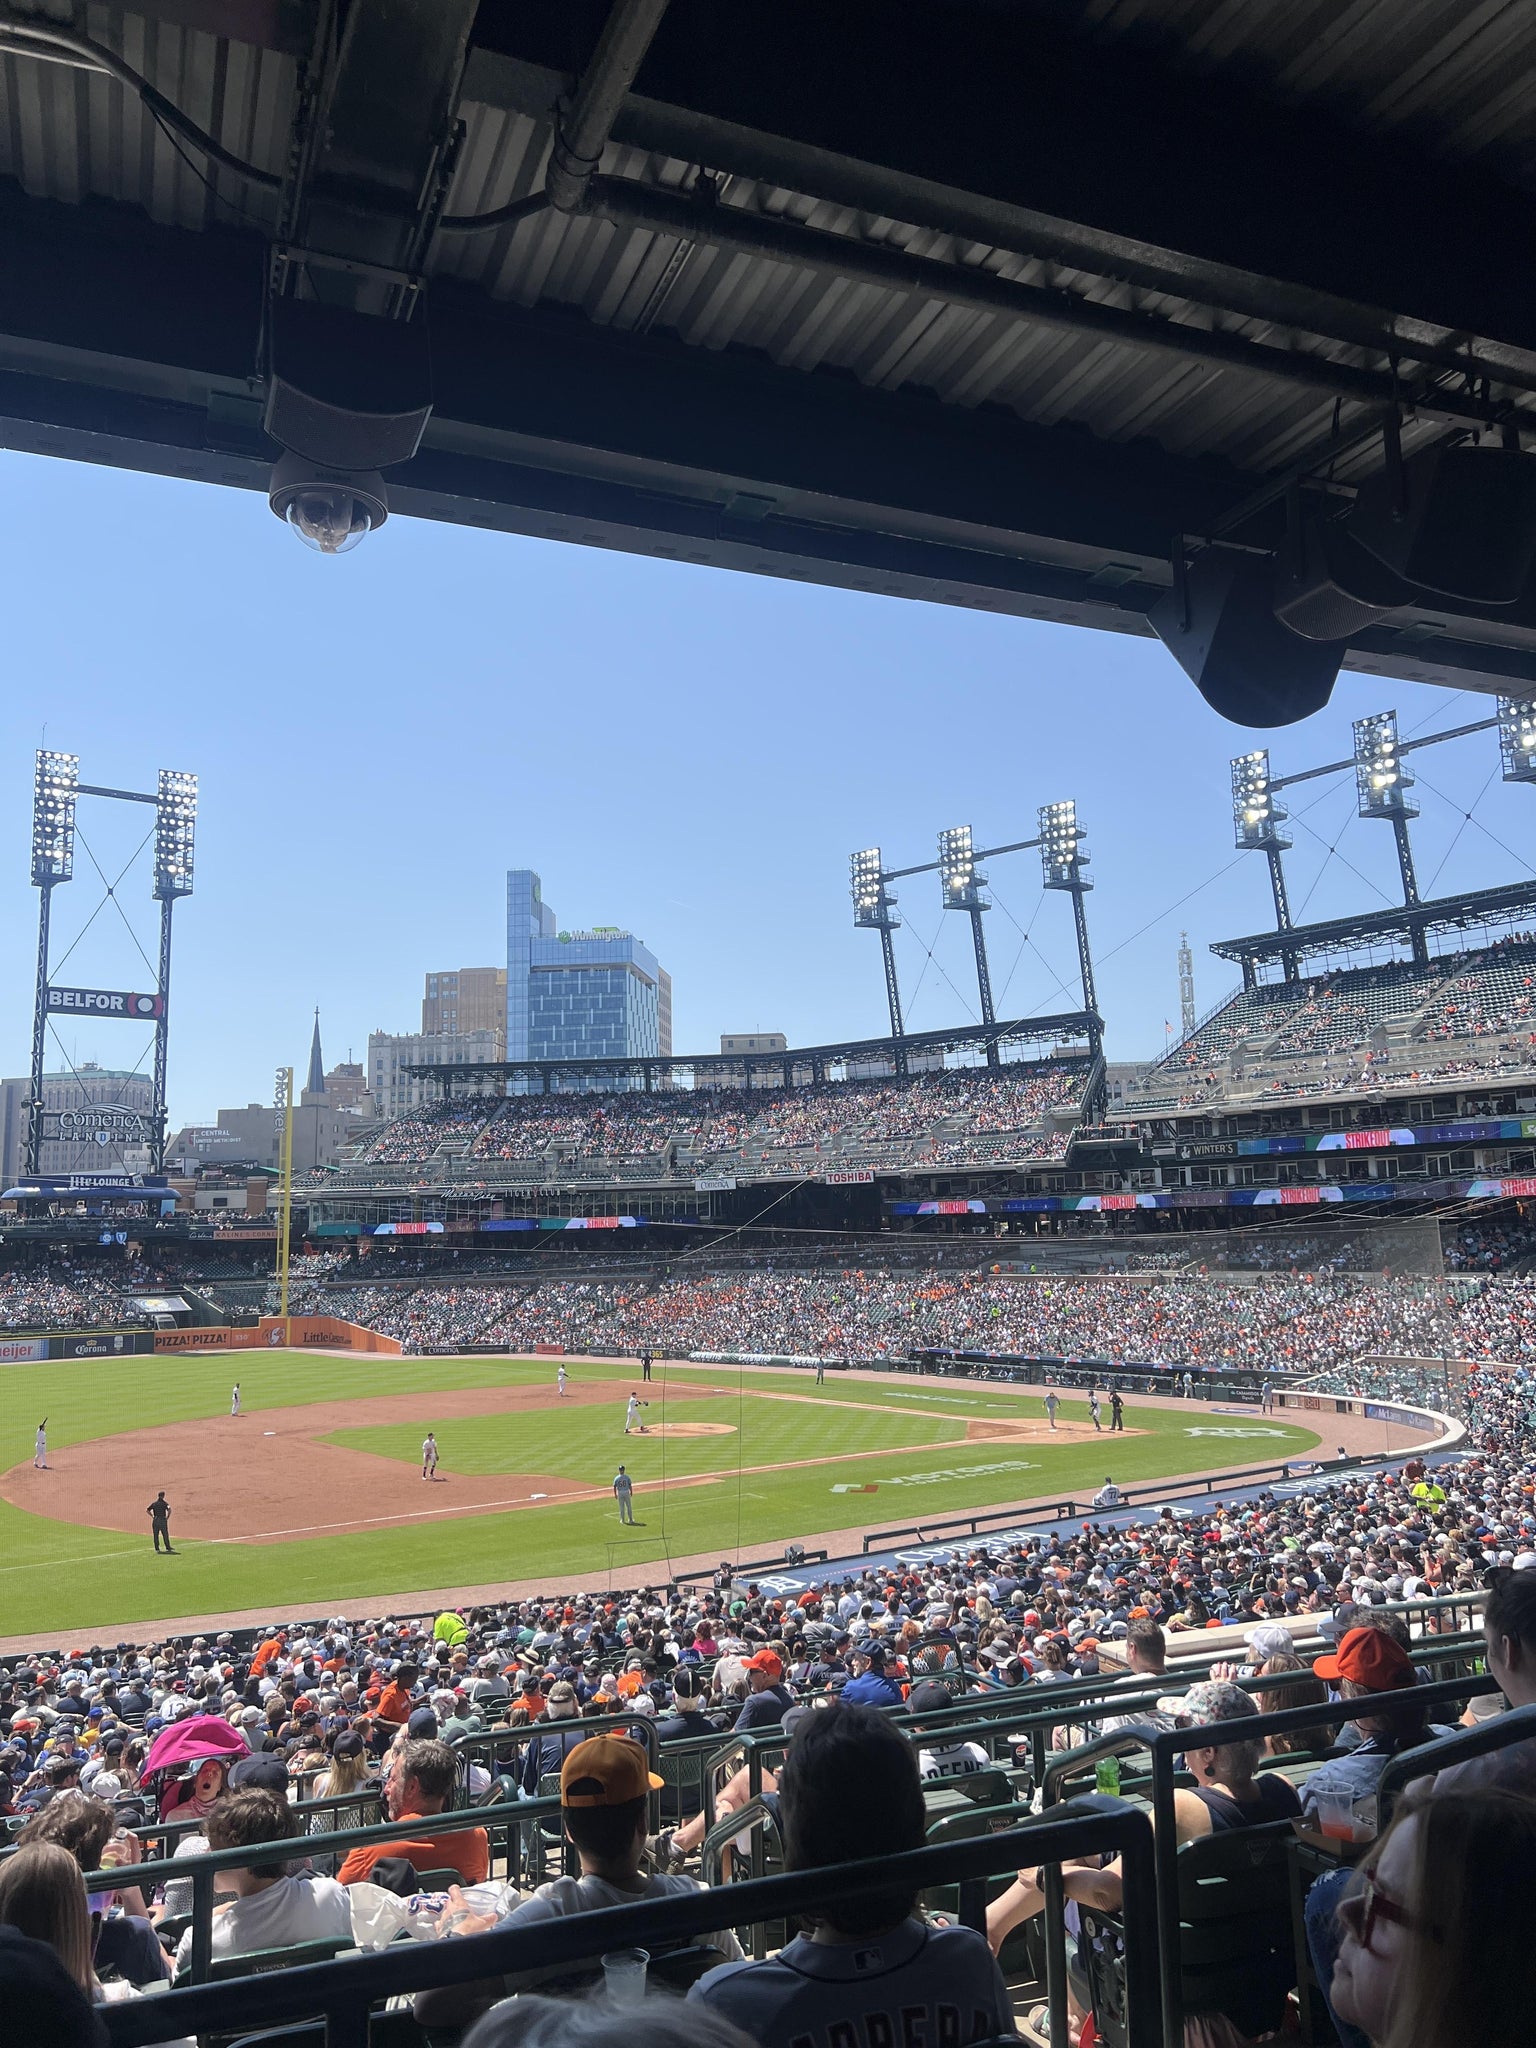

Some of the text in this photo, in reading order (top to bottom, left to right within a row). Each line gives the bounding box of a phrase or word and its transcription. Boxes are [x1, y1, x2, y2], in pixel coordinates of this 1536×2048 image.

[572, 929, 630, 943] Huntington
[49, 991, 124, 1010] BELFOR
[274, 1081, 288, 1134] Rocket
[200, 1130, 231, 1138] CENTRAL
[1345, 1129, 1391, 1148] STRIKEOUT
[1193, 1143, 1234, 1156] WINTER'S
[93, 1177, 131, 1187] LOUNGE
[827, 1171, 872, 1184] TOSHIBA
[504, 1187, 561, 1198] TIGER CLUB
[1280, 1186, 1320, 1204] STRIKEOUT
[937, 1200, 968, 1213] STRIKEOUT
[1100, 1194, 1136, 1210] STRIKEOUT
[586, 1216, 619, 1229] STRIKEOUT
[155, 1333, 227, 1347] PIZZA! PIZZA!
[303, 1332, 329, 1343] Little
[0, 1343, 33, 1359] eijer
[75, 1344, 107, 1355] Corona
[874, 1460, 1030, 1484] VICTORS
